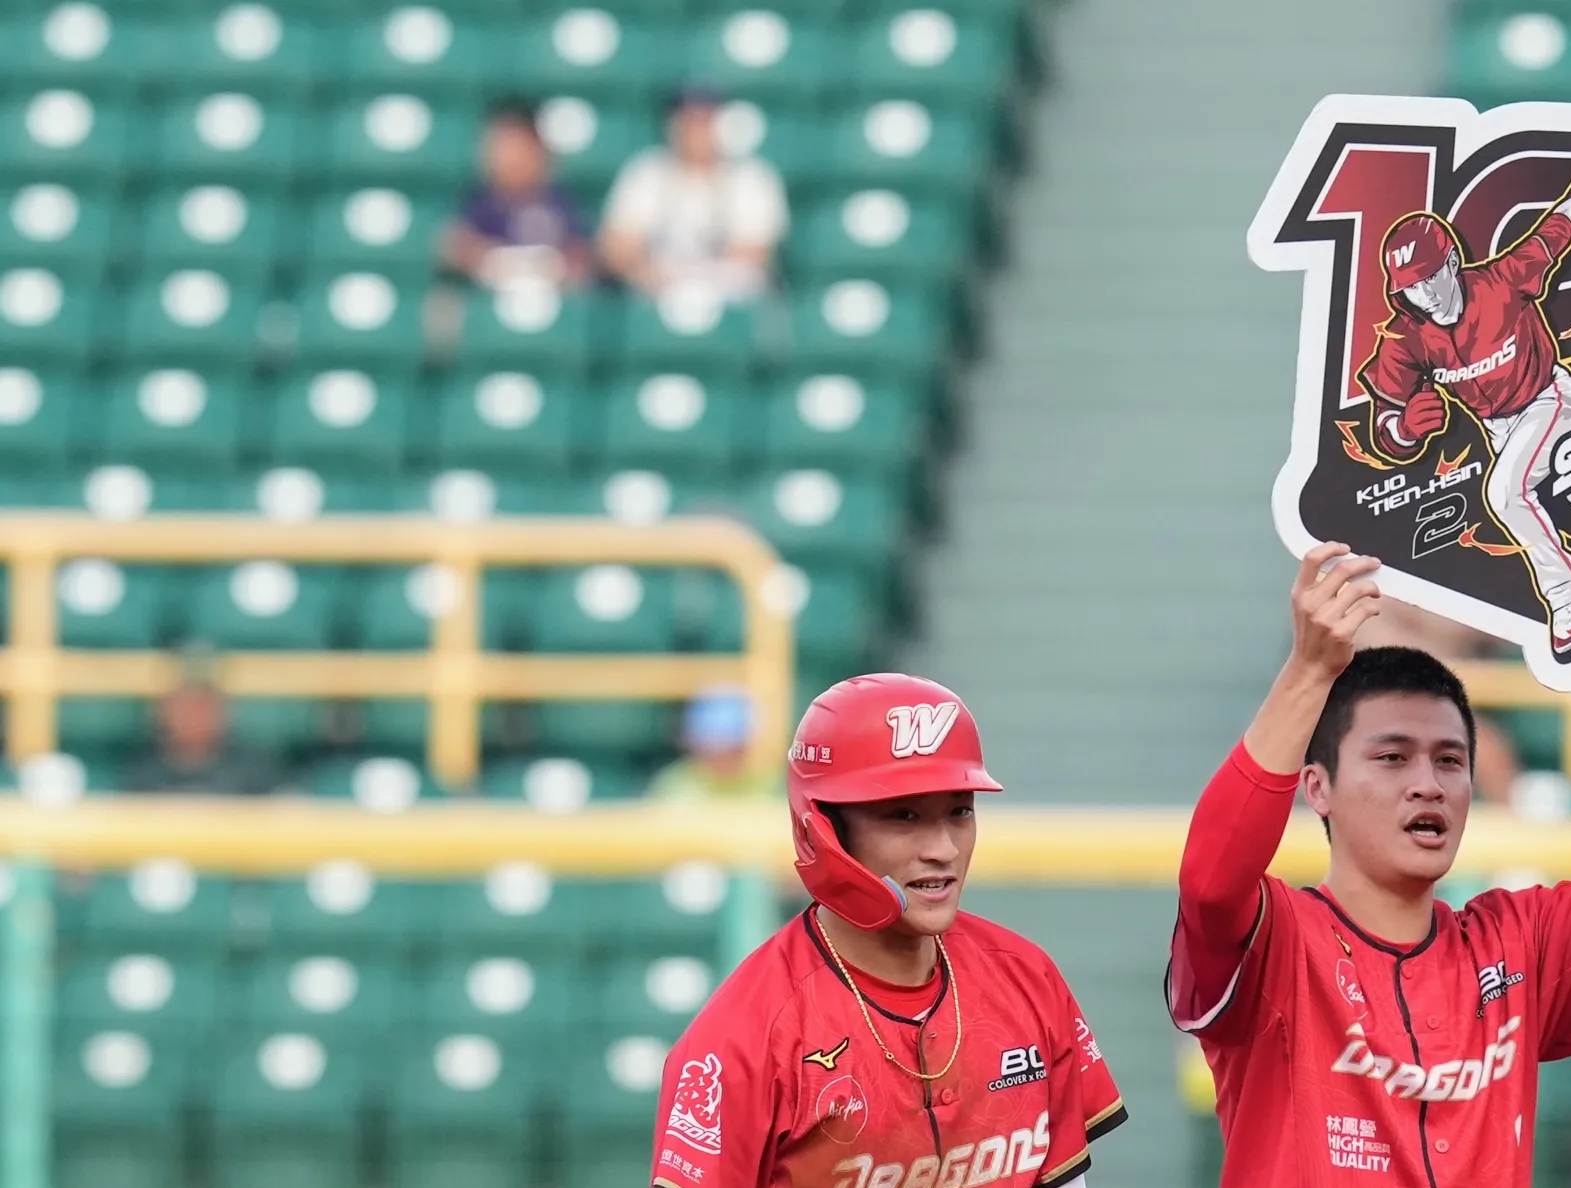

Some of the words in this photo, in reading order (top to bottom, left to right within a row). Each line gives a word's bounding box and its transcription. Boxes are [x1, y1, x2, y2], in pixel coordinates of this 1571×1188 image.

[1432, 334, 1517, 384] DRAGONS
[1356, 473, 1406, 505] KUO
[886, 702, 960, 759] W
[988, 1074, 1028, 1091] COLOVER
[1327, 1133, 1364, 1153] HIGH
